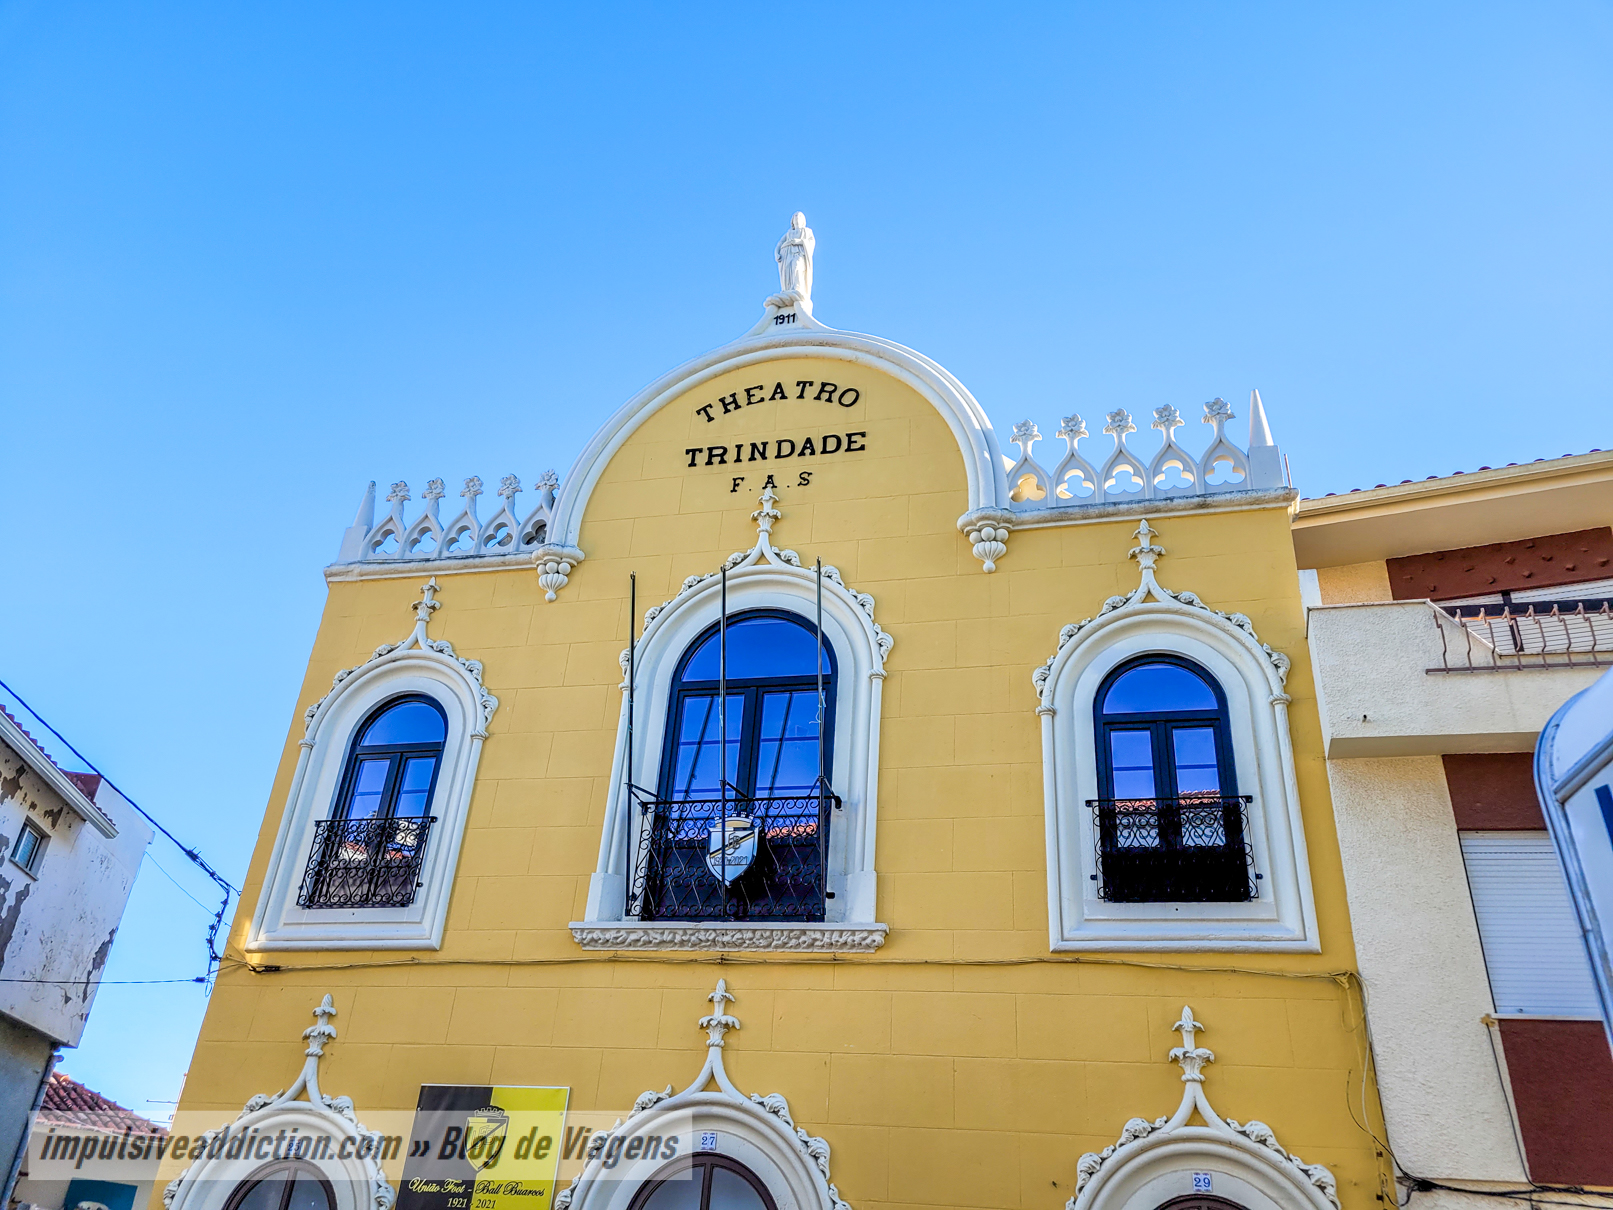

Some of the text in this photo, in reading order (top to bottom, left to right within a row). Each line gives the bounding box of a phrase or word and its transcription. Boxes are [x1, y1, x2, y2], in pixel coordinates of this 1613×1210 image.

[773, 312, 797, 326] 1911
[695, 380, 860, 423] THEATRO
[685, 431, 867, 467] TRINDADE
[701, 1136, 716, 1146] 27
[408, 1176, 440, 1193] União
[441, 1178, 466, 1194] Foot
[475, 1179, 501, 1195] Ball
[502, 1180, 546, 1197] Buarcos
[1193, 1176, 1211, 1188] 29
[446, 1197, 468, 1208] 1921
[475, 1199, 497, 1209] 2021
